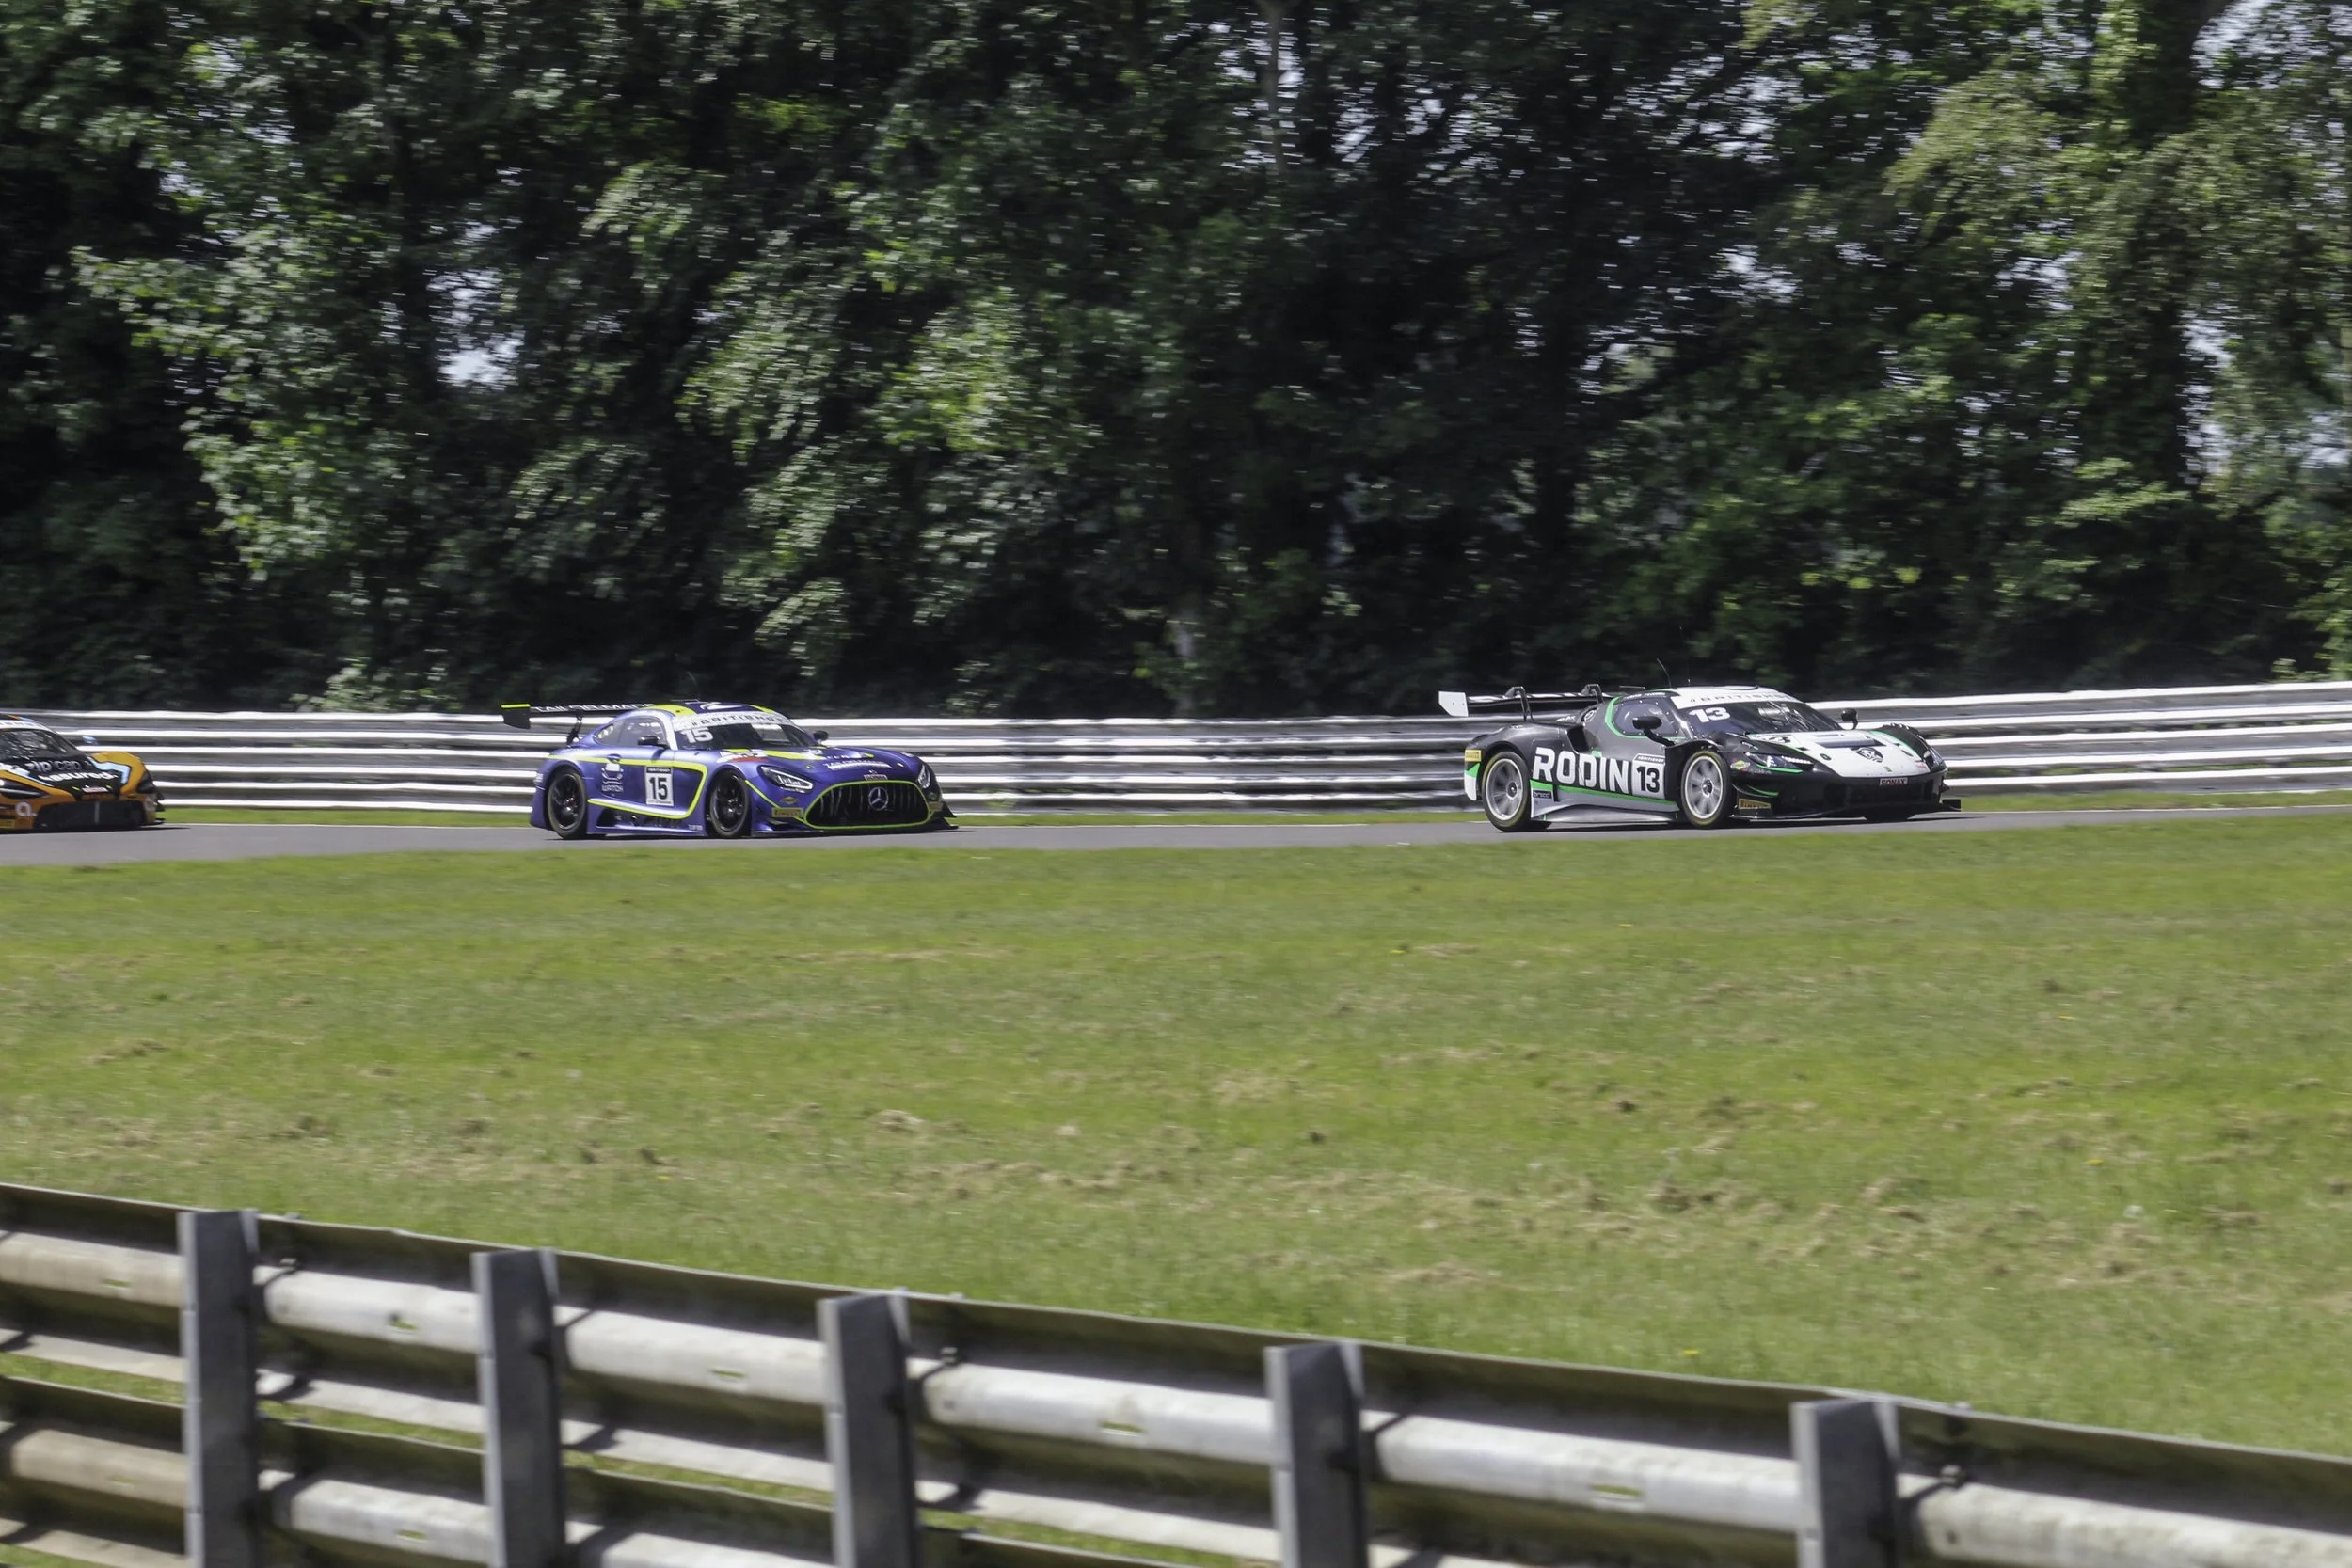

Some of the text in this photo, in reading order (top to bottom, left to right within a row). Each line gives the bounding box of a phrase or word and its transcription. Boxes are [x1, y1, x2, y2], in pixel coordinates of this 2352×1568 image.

[1689, 707, 1730, 723] 13
[680, 727, 713, 744] 15
[1533, 747, 1629, 794] RODIN
[1636, 766, 1660, 793] 13
[649, 777, 668, 800] 15
